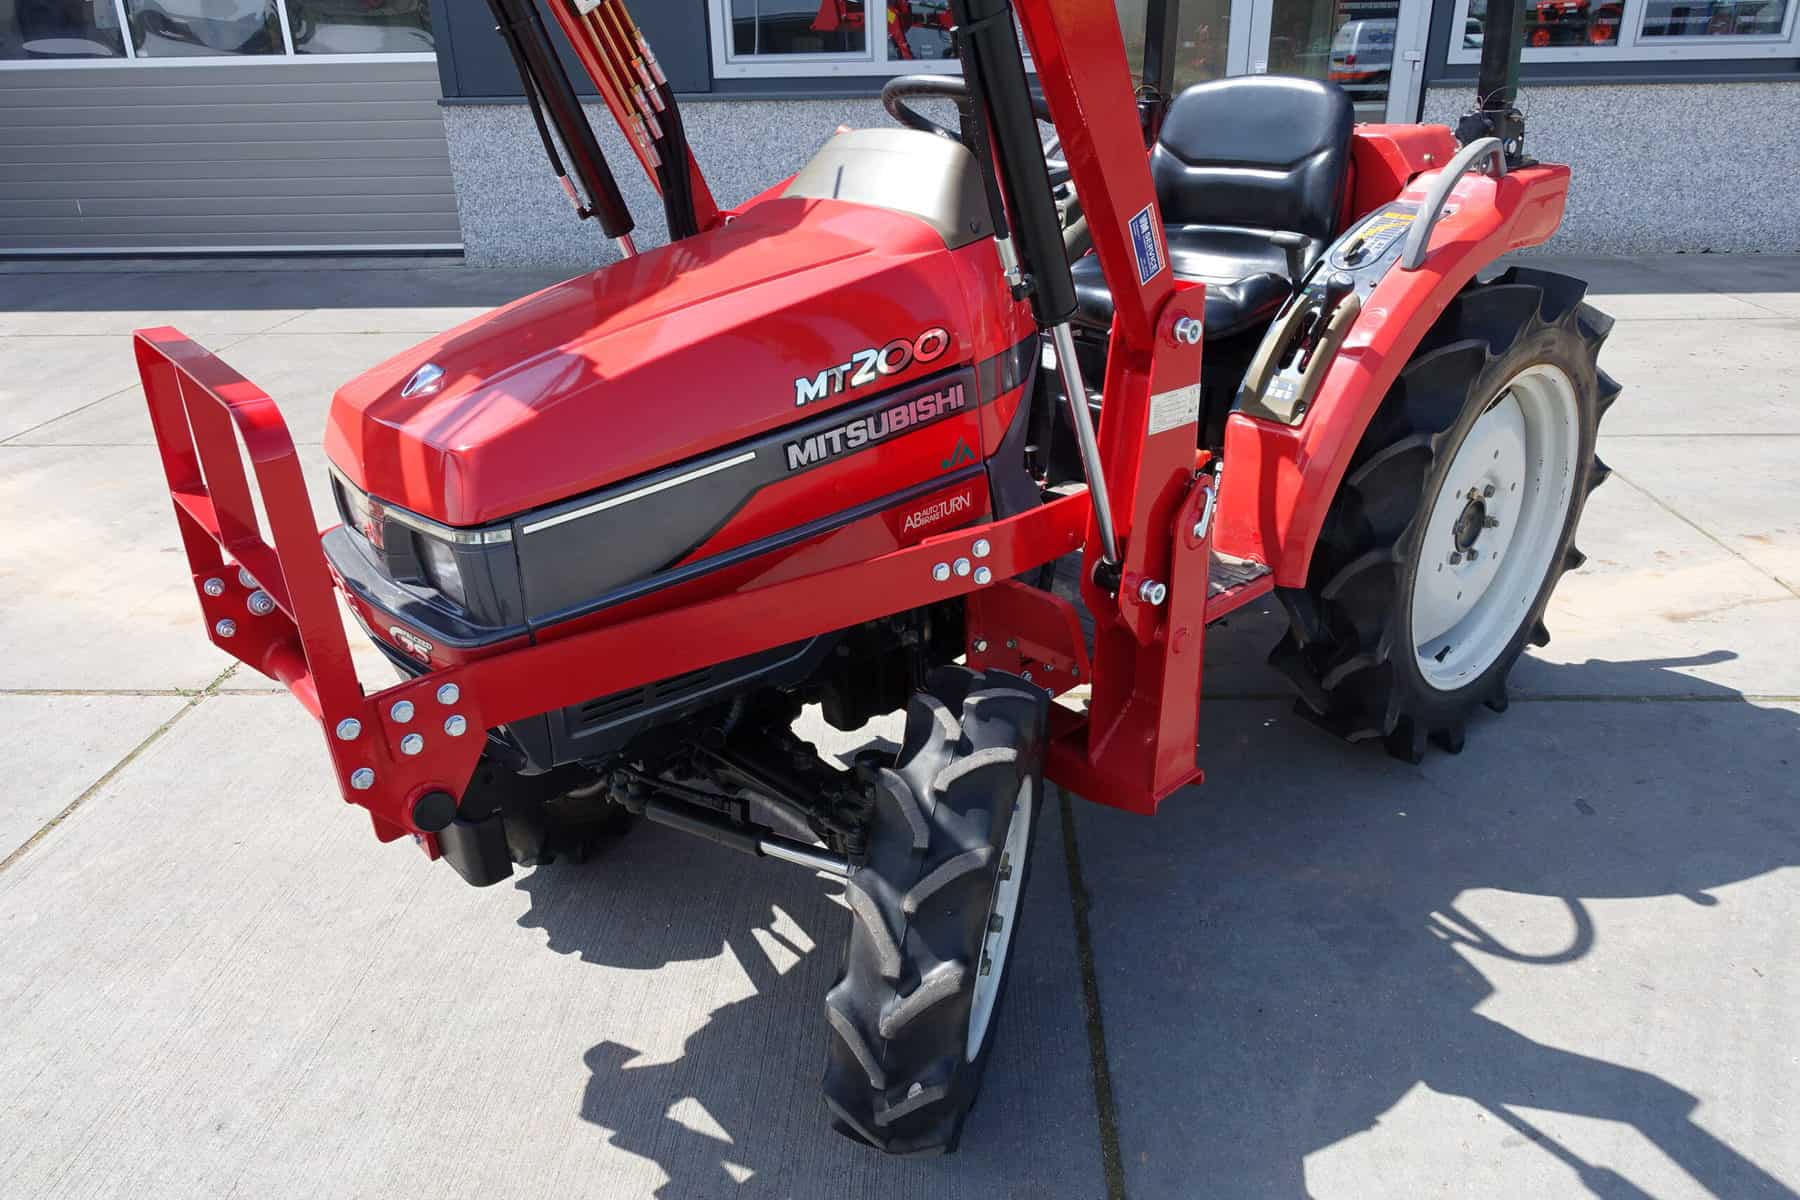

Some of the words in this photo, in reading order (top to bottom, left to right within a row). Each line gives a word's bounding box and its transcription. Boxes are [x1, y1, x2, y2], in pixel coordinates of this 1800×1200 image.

[1143, 231, 1158, 273] SERVICE
[795, 327, 949, 406] MT200
[787, 384, 965, 470] MITSUBISHI
[904, 511, 922, 533] AB
[921, 504, 939, 516] AUTO
[939, 492, 970, 517] TURN
